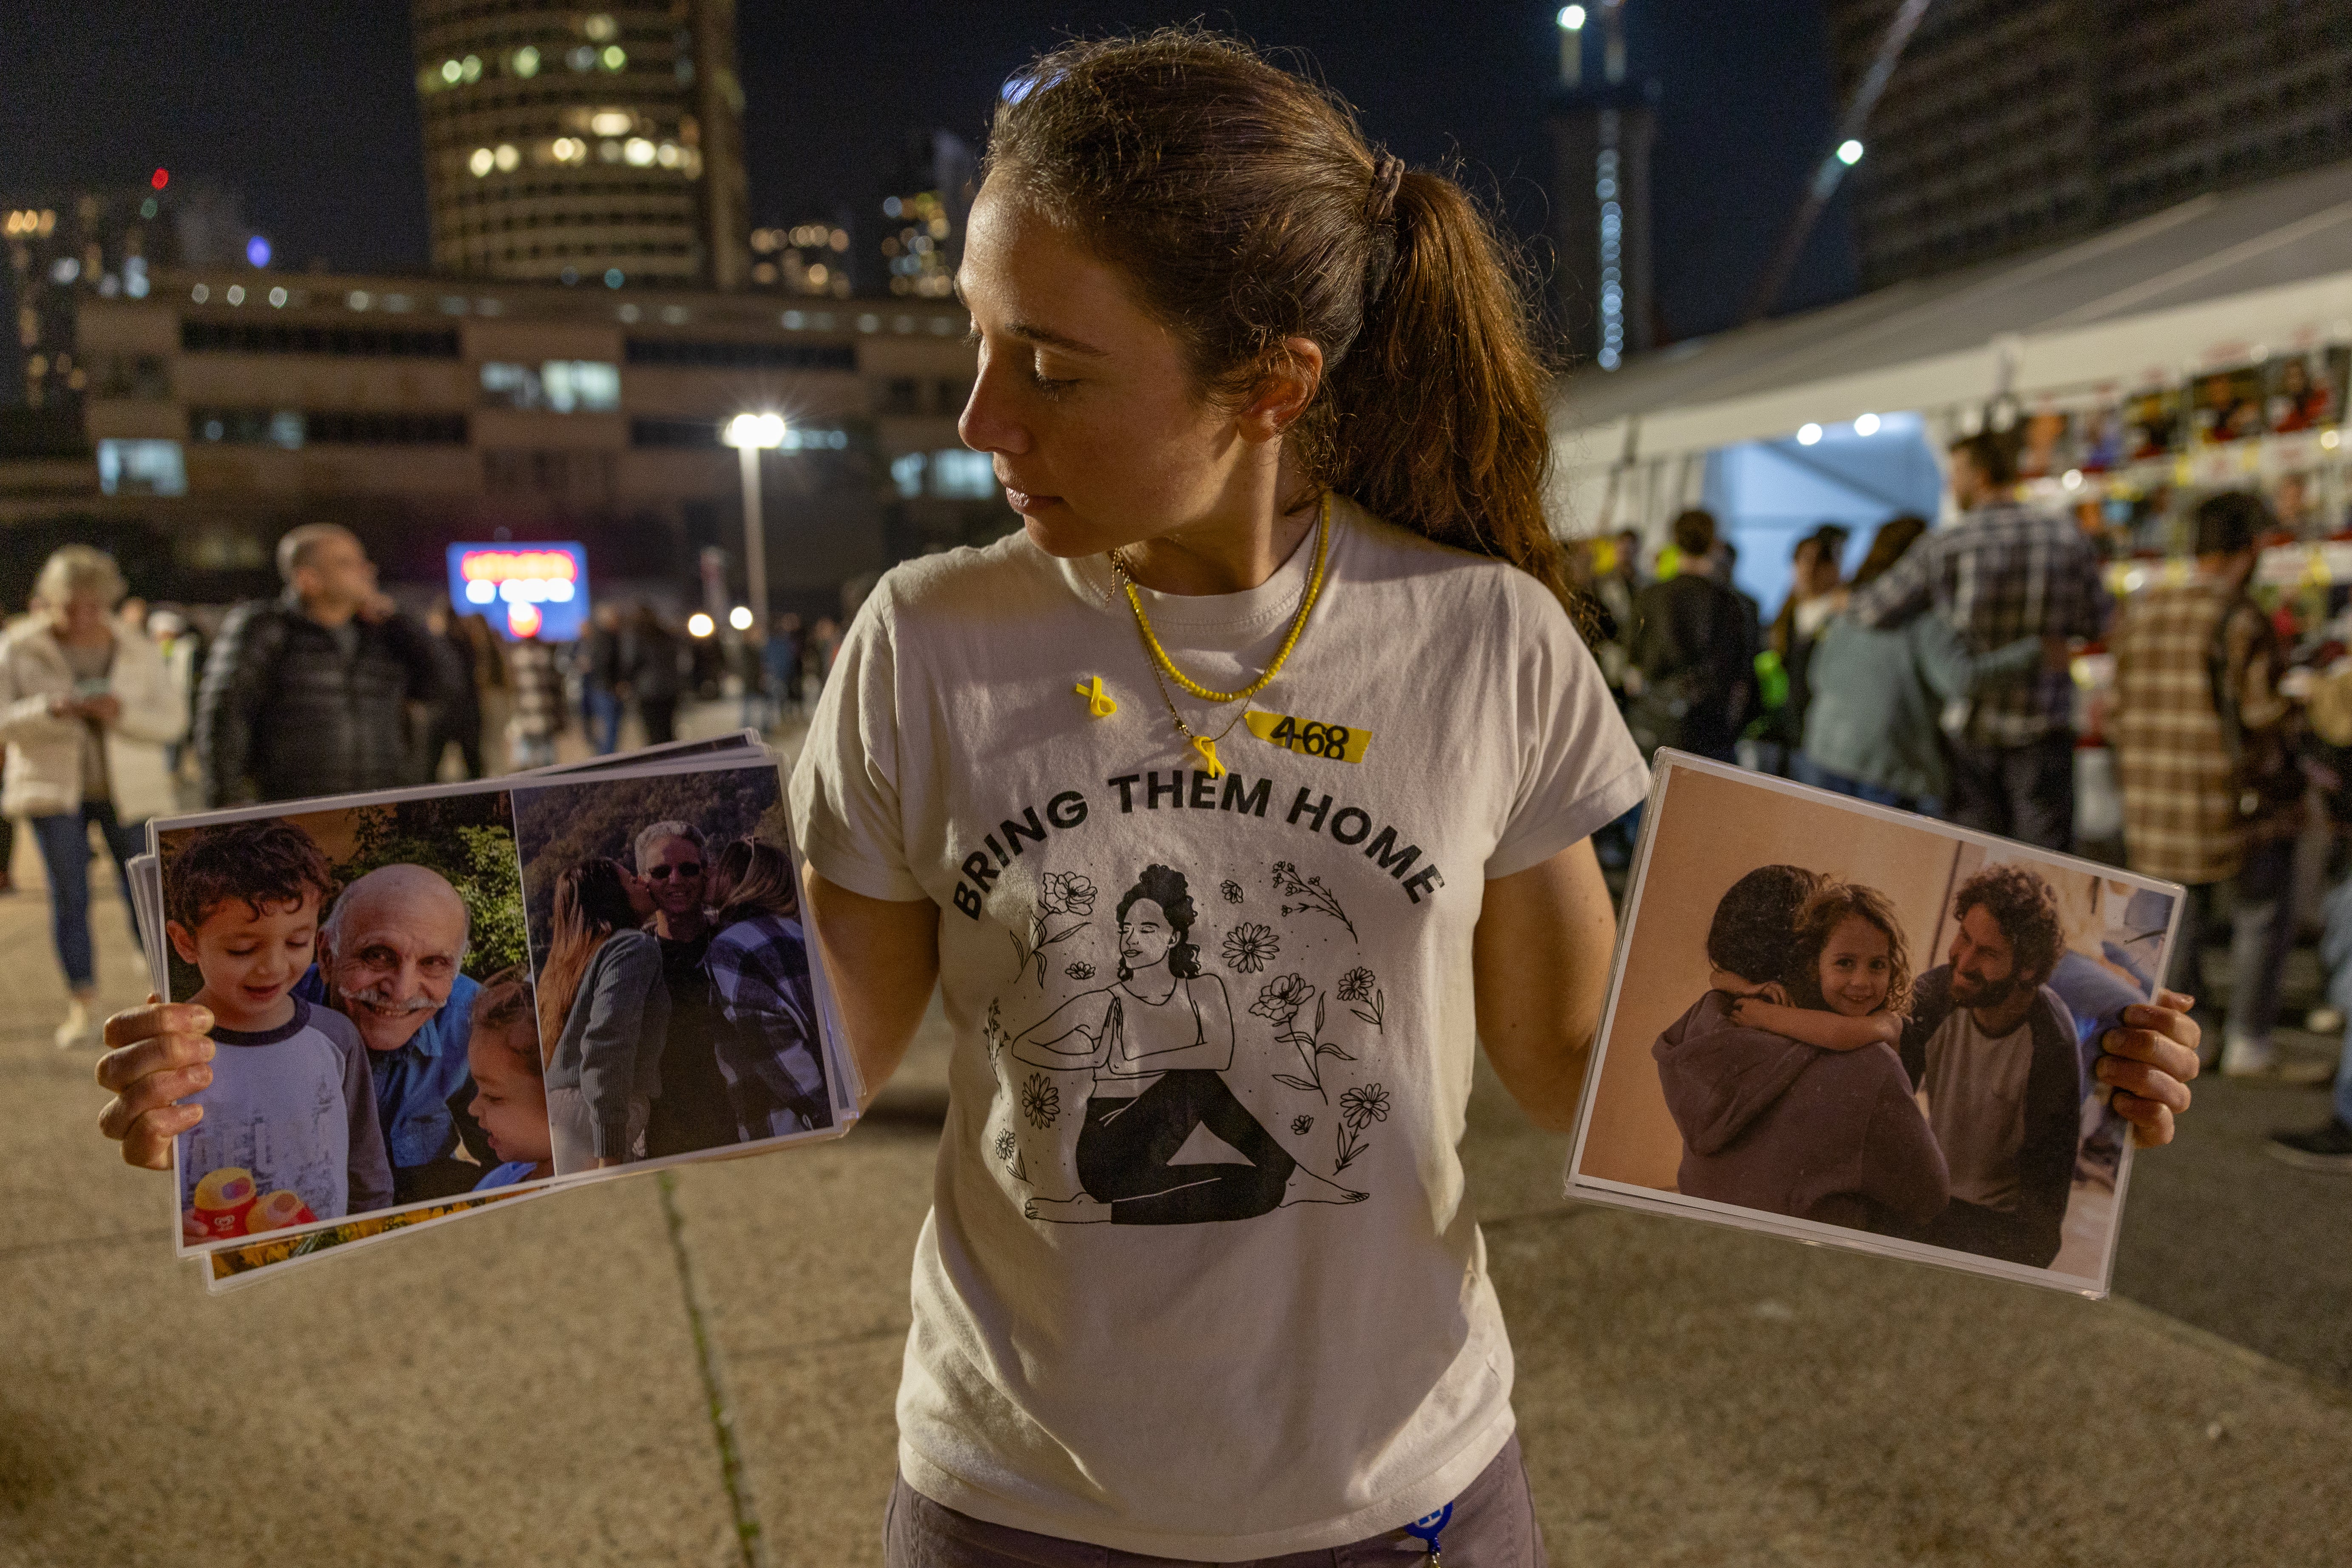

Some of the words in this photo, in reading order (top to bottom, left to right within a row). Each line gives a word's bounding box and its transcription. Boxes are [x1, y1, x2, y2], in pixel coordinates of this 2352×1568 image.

[1270, 716, 1350, 760] 468
[953, 790, 1089, 921] BRING
[1107, 770, 1273, 817] THEM
[1286, 786, 1445, 905] HOME
